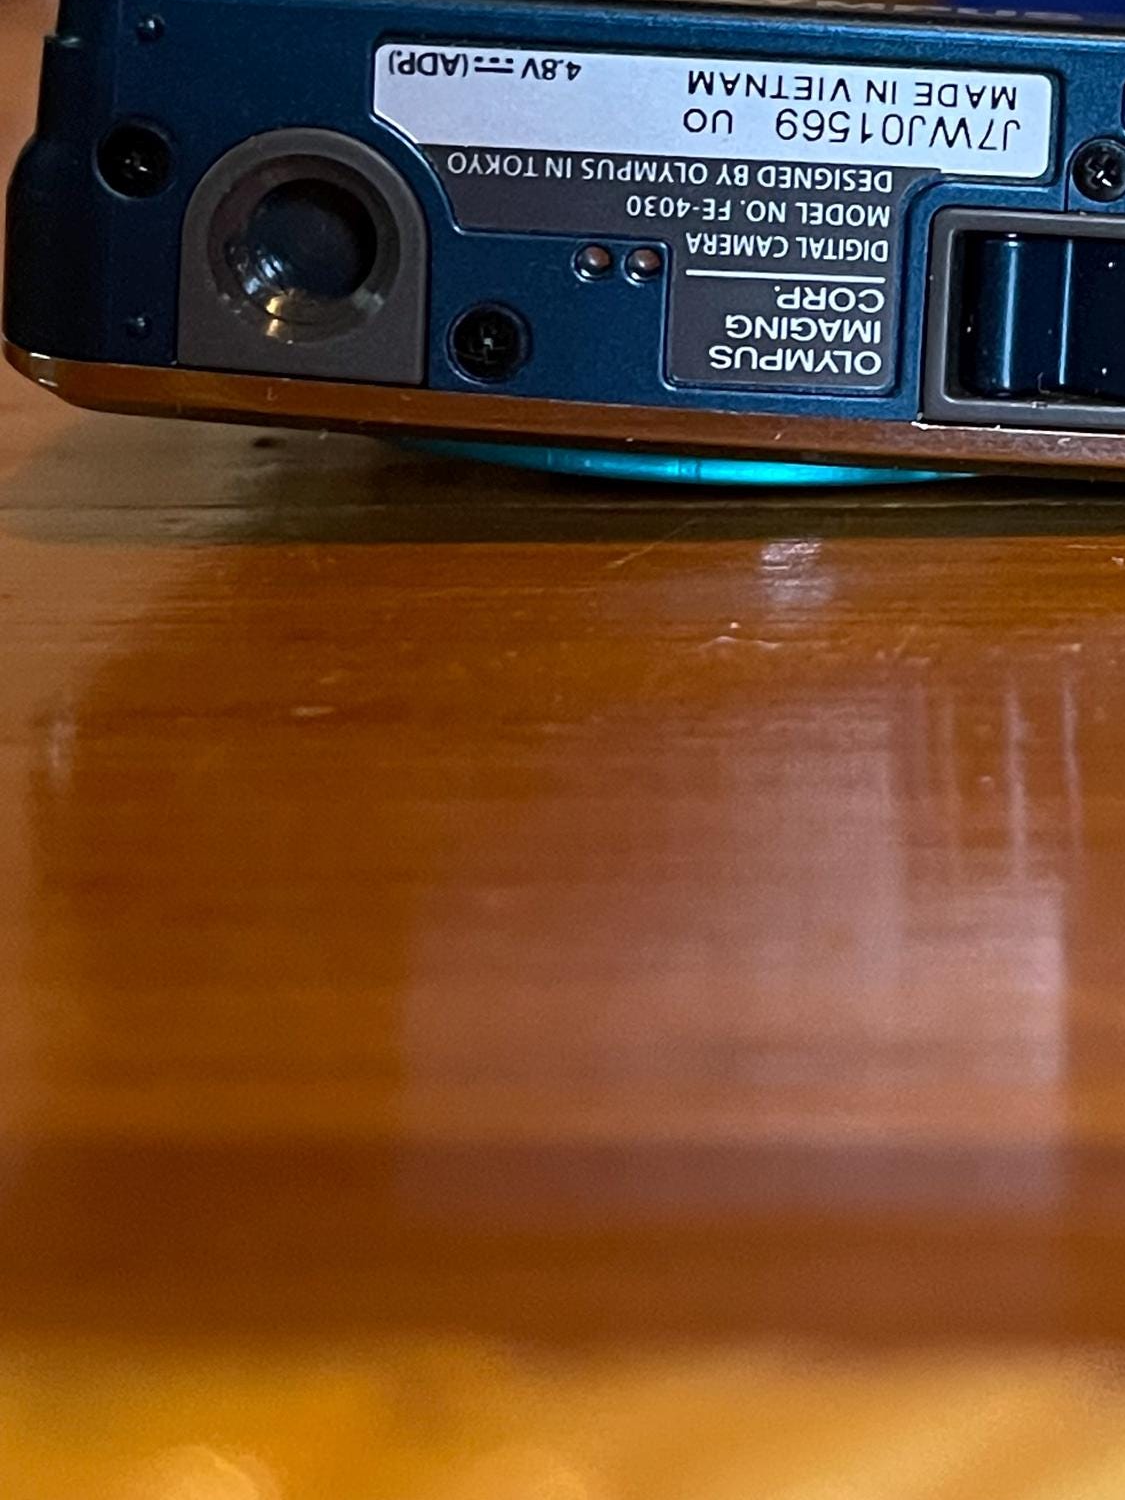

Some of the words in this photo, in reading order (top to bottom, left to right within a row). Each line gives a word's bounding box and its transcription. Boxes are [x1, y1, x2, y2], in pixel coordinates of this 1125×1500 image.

[521, 57, 582, 81] 4.8V
[687, 69, 851, 102] VIETNAM
[866, 77, 897, 102] IN
[914, 81, 1018, 111] MADE
[775, 107, 1021, 152] J7WJ01569
[447, 151, 539, 178] TOKYO
[545, 156, 571, 178] IN
[581, 157, 709, 186] OLYMPUS
[716, 163, 749, 187] BY
[757, 164, 894, 193] DESIGNED
[626, 194, 731, 221] FE-4030
[740, 199, 786, 224] NO.
[798, 201, 891, 228] MODEL
[685, 231, 790, 259] CAMERA
[796, 235, 889, 263] DIGITAL
[774, 285, 886, 314] CORP.
[725, 313, 882, 344] IMAGING
[708, 344, 883, 376] OLYMPUS
